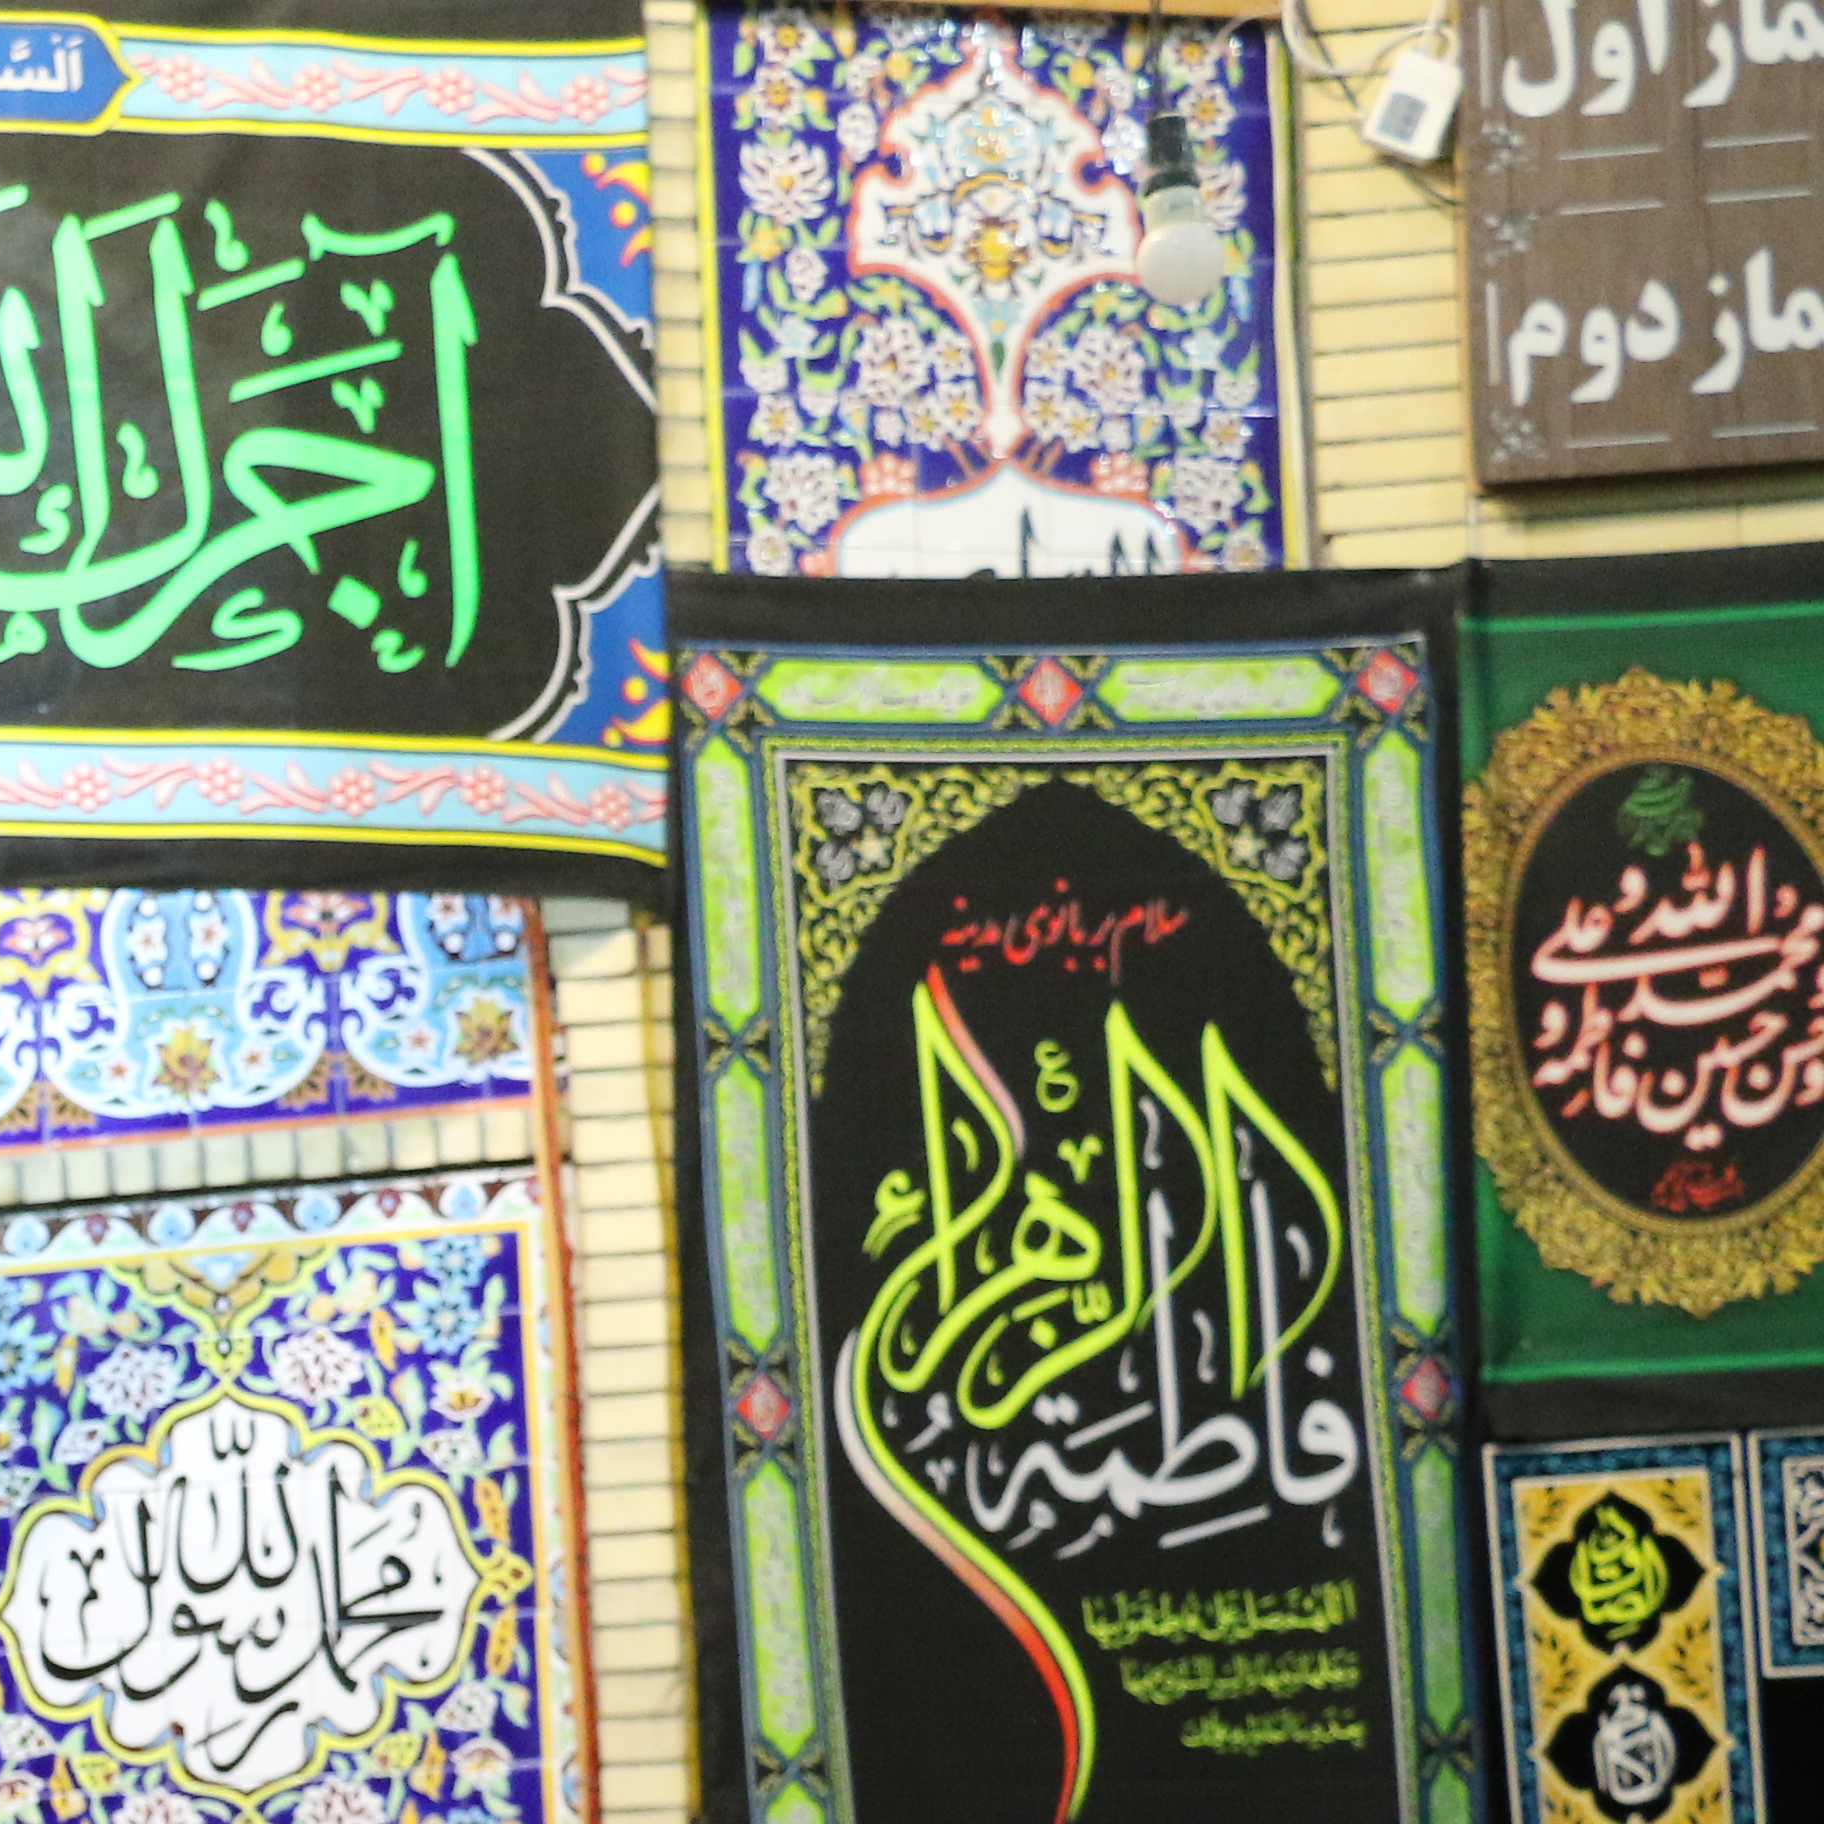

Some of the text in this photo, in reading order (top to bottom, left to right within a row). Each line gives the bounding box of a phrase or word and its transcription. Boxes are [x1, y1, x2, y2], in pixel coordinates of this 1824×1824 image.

[1502, 0, 1824, 117] ماز اول
[1507, 246, 1824, 408] ماز دوم
[940, 894, 1002, 973] مدینه
[1002, 876, 1086, 977] بانوی
[1109, 896, 1190, 987] سلام
